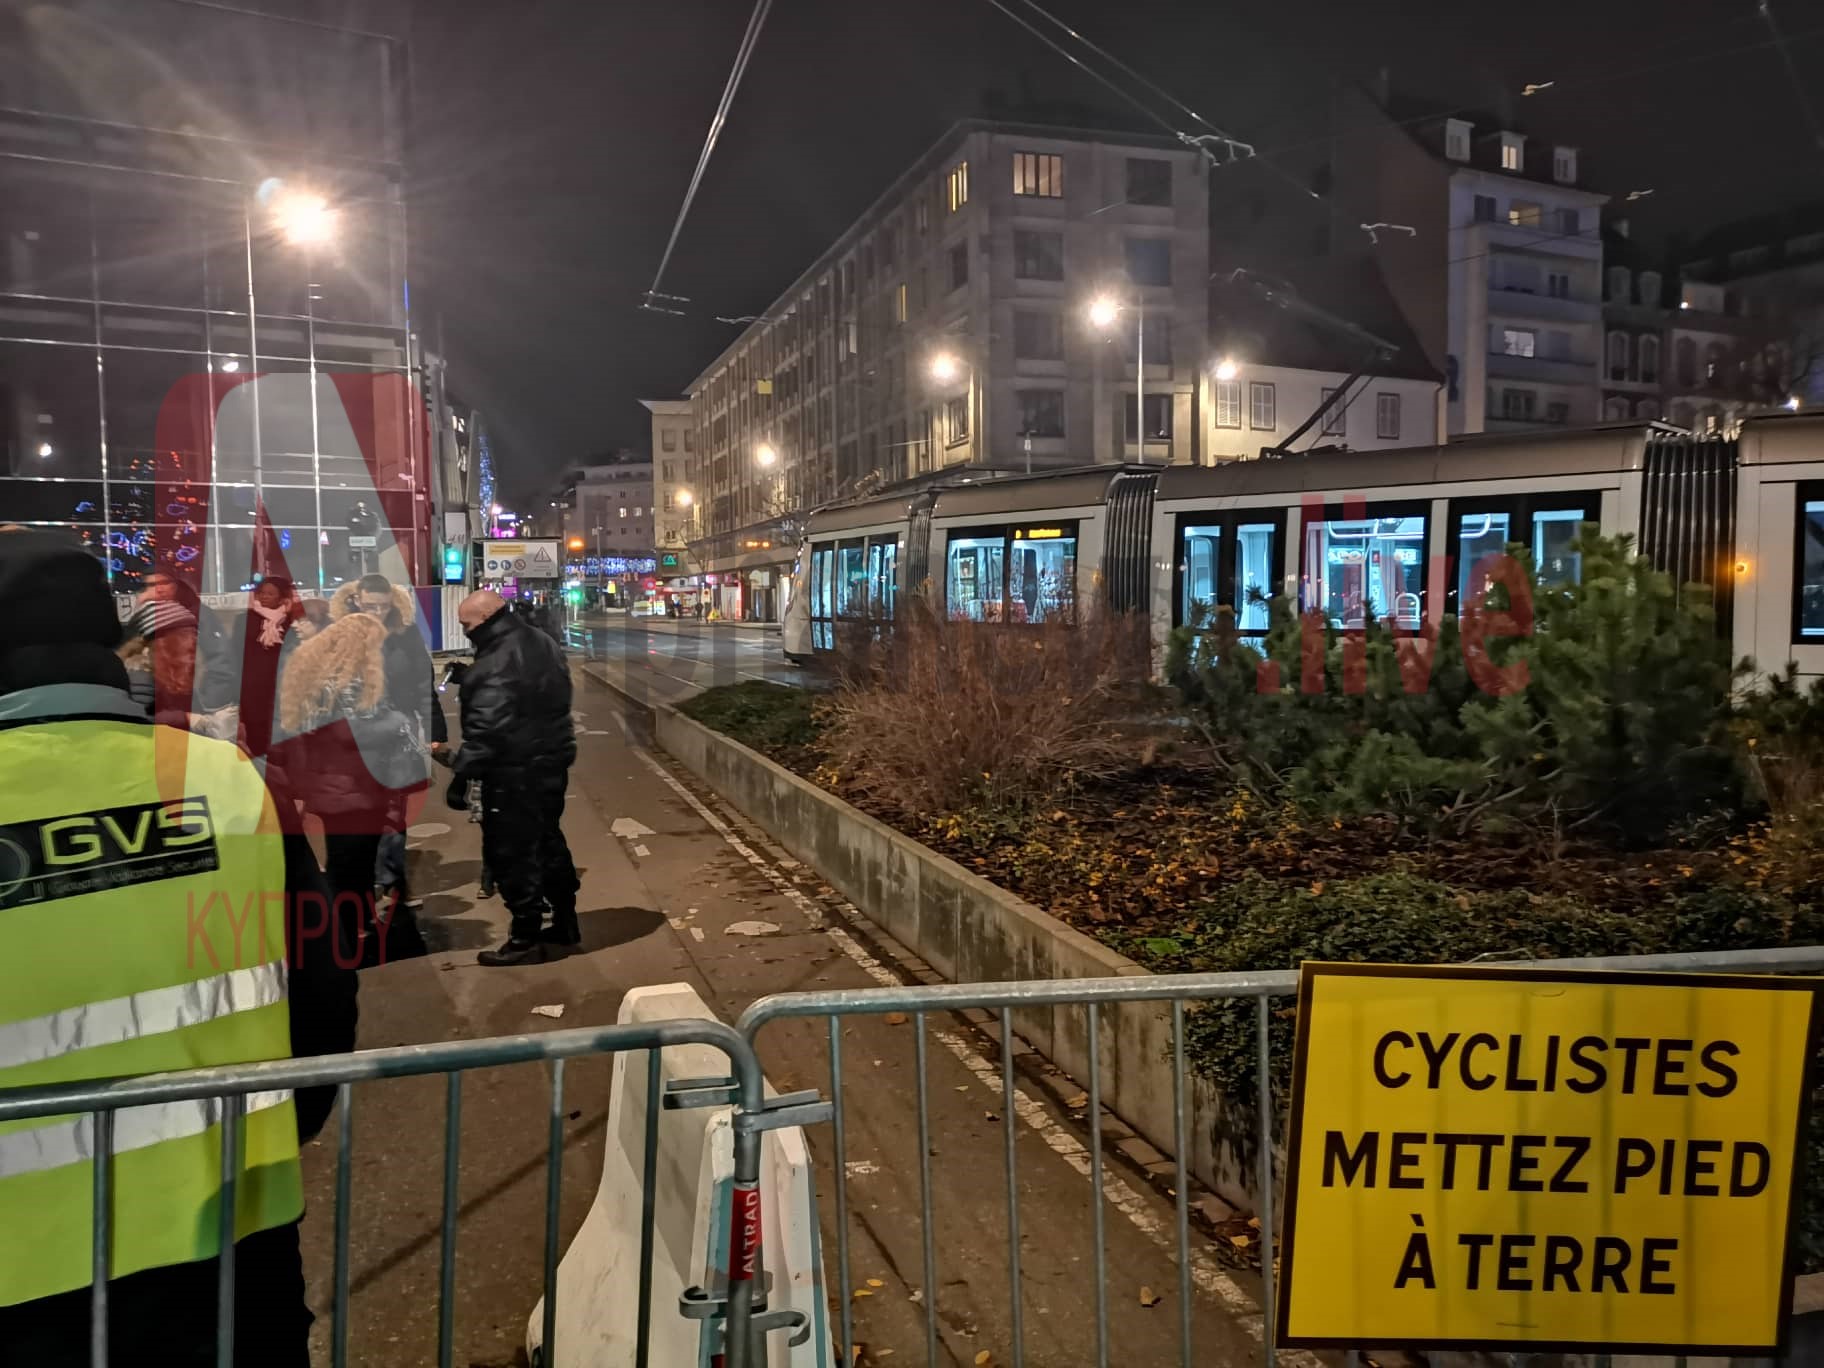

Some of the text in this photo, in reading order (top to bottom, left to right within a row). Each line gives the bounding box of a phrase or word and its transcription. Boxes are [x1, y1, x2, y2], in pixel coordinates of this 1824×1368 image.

[39, 801, 212, 865] GVS
[1373, 1030, 1741, 1098] CYCLISTES
[1321, 1130, 1771, 1198] METTEZ PIED
[1393, 1213, 1680, 1295] À TERRE
